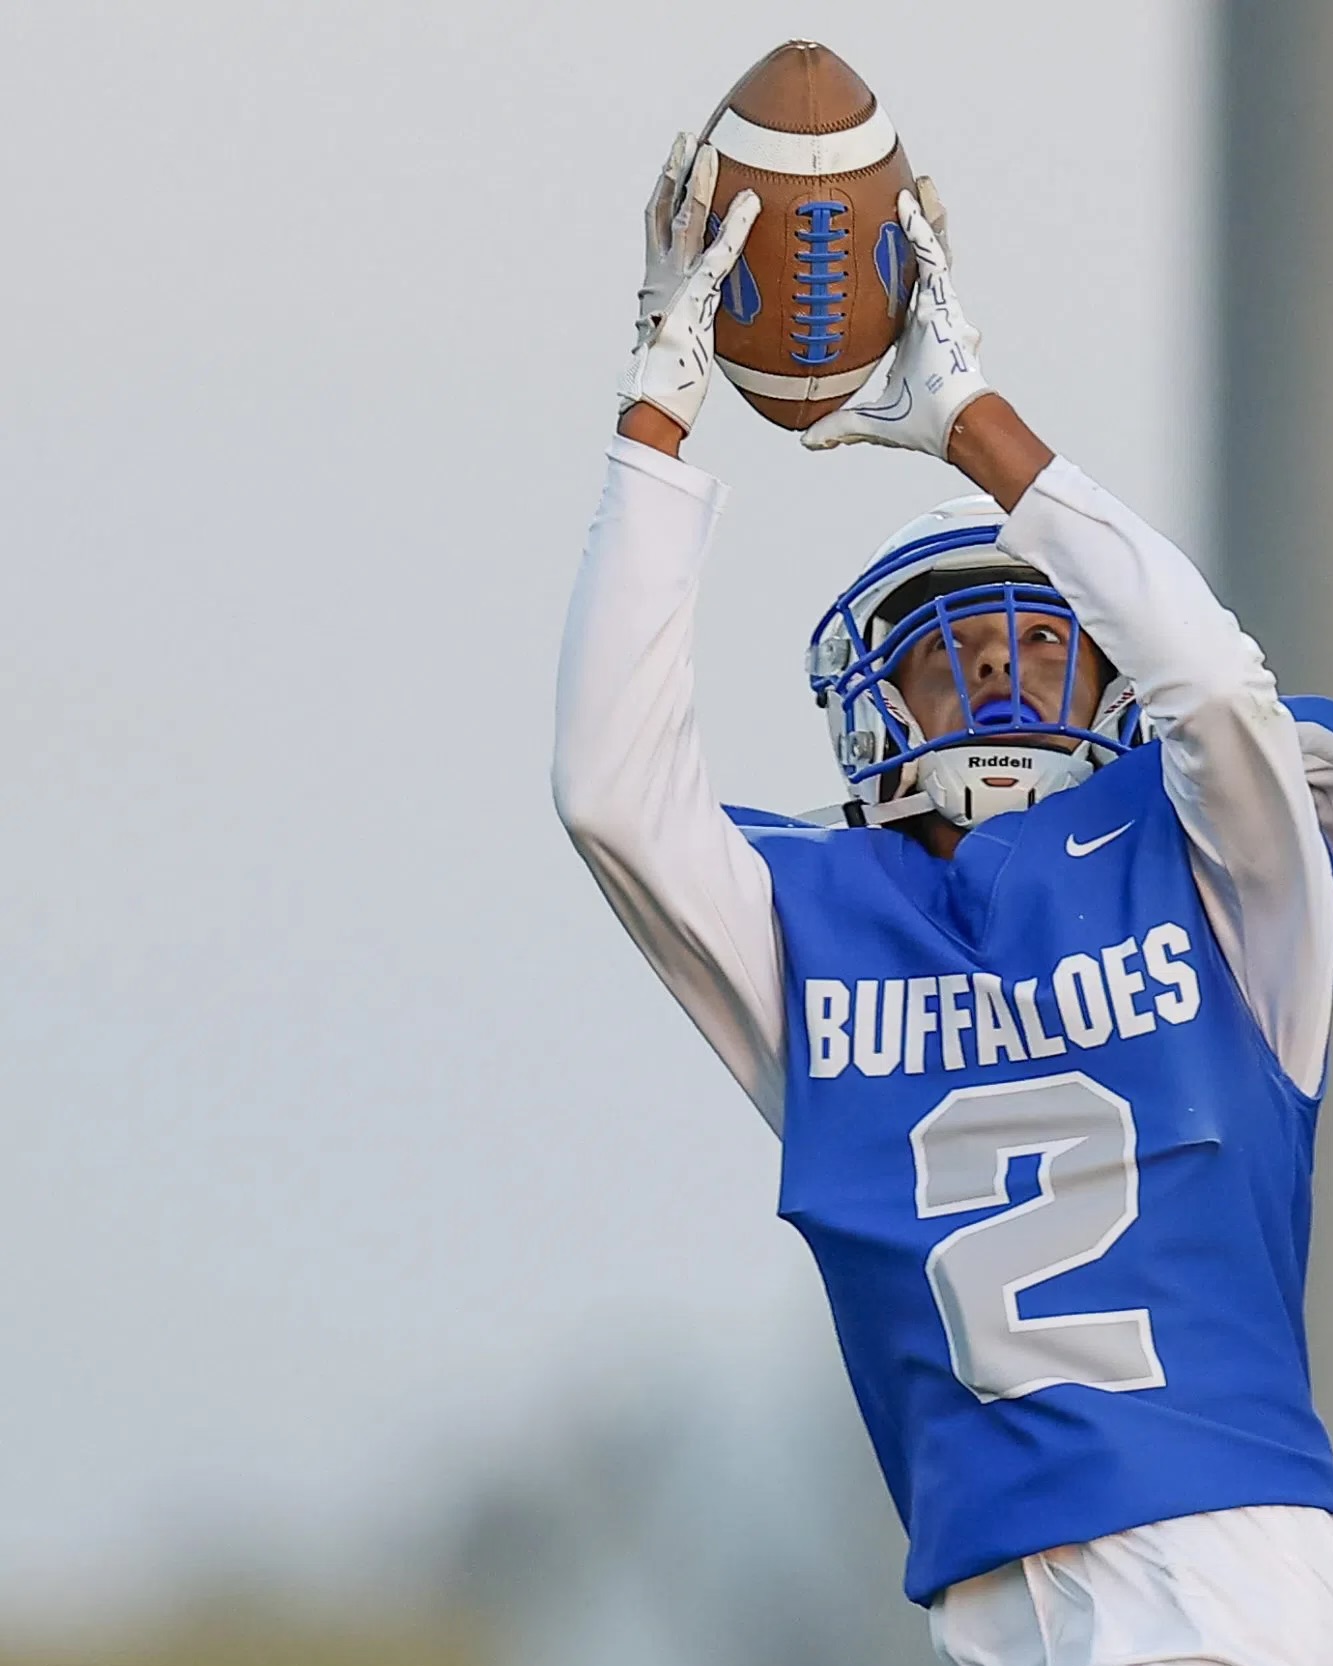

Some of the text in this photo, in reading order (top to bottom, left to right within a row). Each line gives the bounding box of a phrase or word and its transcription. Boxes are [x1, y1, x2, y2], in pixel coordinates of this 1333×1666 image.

[968, 755, 1032, 769] Riddell
[805, 923, 1201, 1078] BUFFALOES
[910, 1070, 1167, 1404] 2
